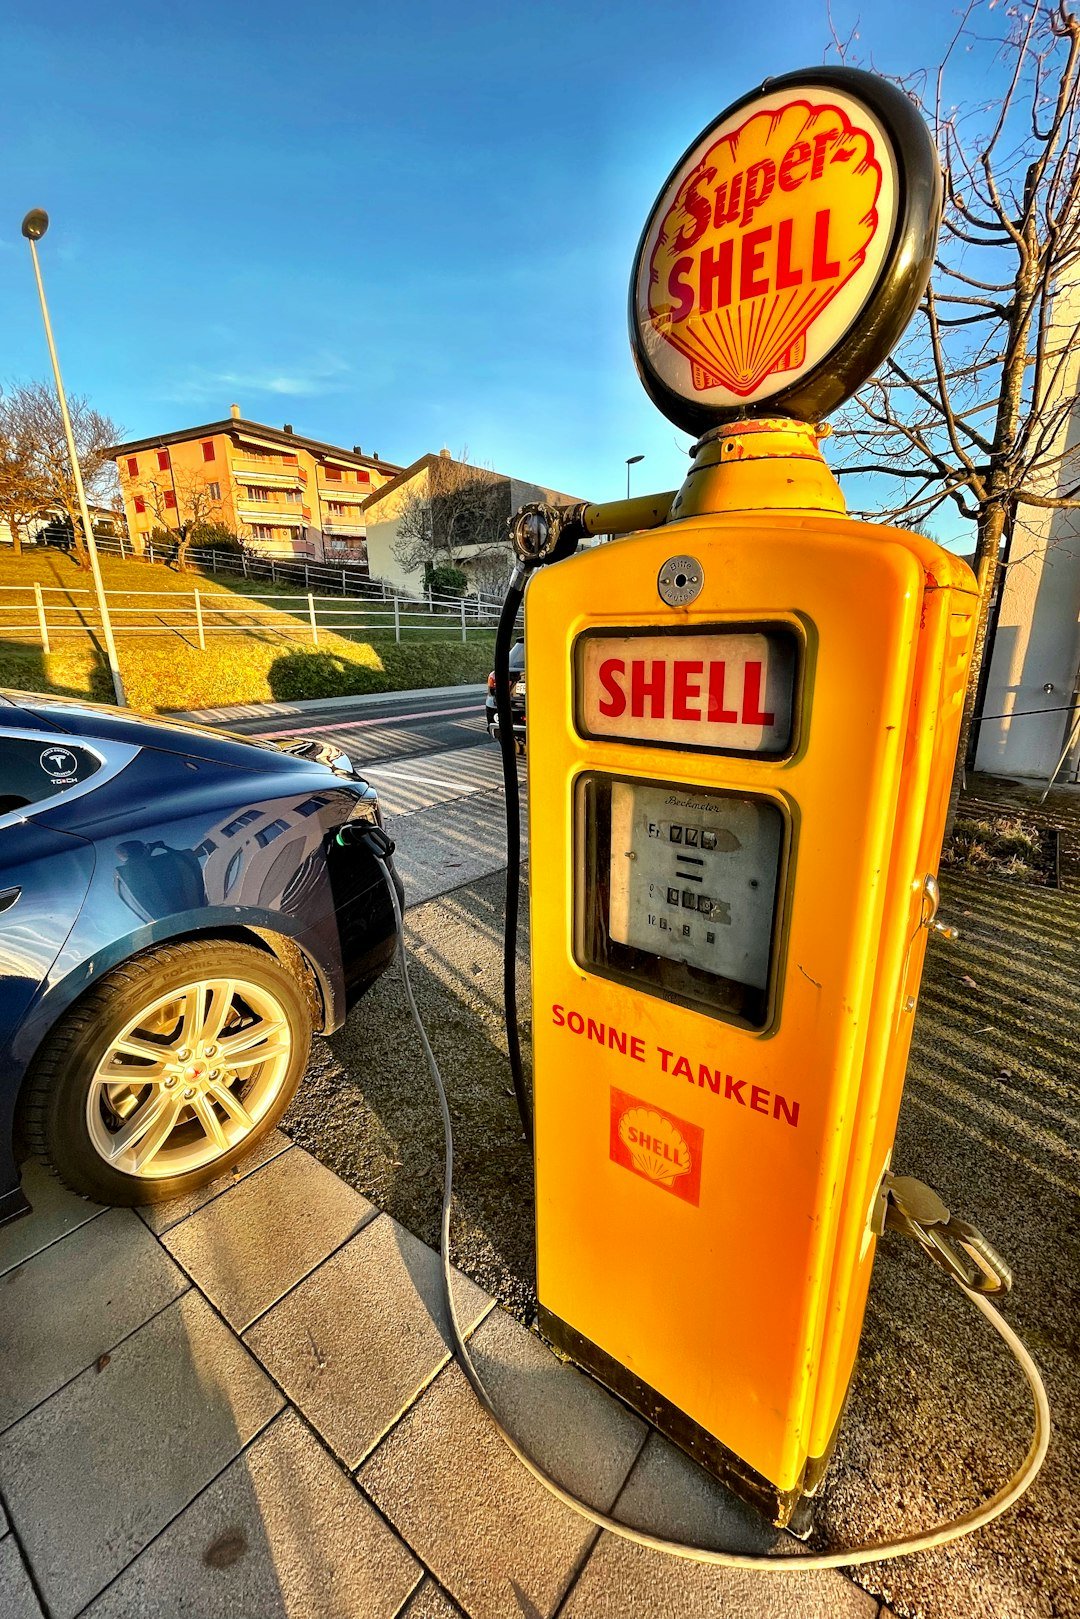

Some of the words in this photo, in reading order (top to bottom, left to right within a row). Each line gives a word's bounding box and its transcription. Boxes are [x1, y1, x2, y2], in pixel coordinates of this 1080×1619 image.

[667, 208, 840, 324] SHELL
[598, 658, 775, 726] SHELL
[162, 960, 213, 980] POLARIS
[551, 1004, 646, 1063] SONNE
[656, 1046, 800, 1128] TANKEN
[627, 1126, 684, 1167] SHELL
